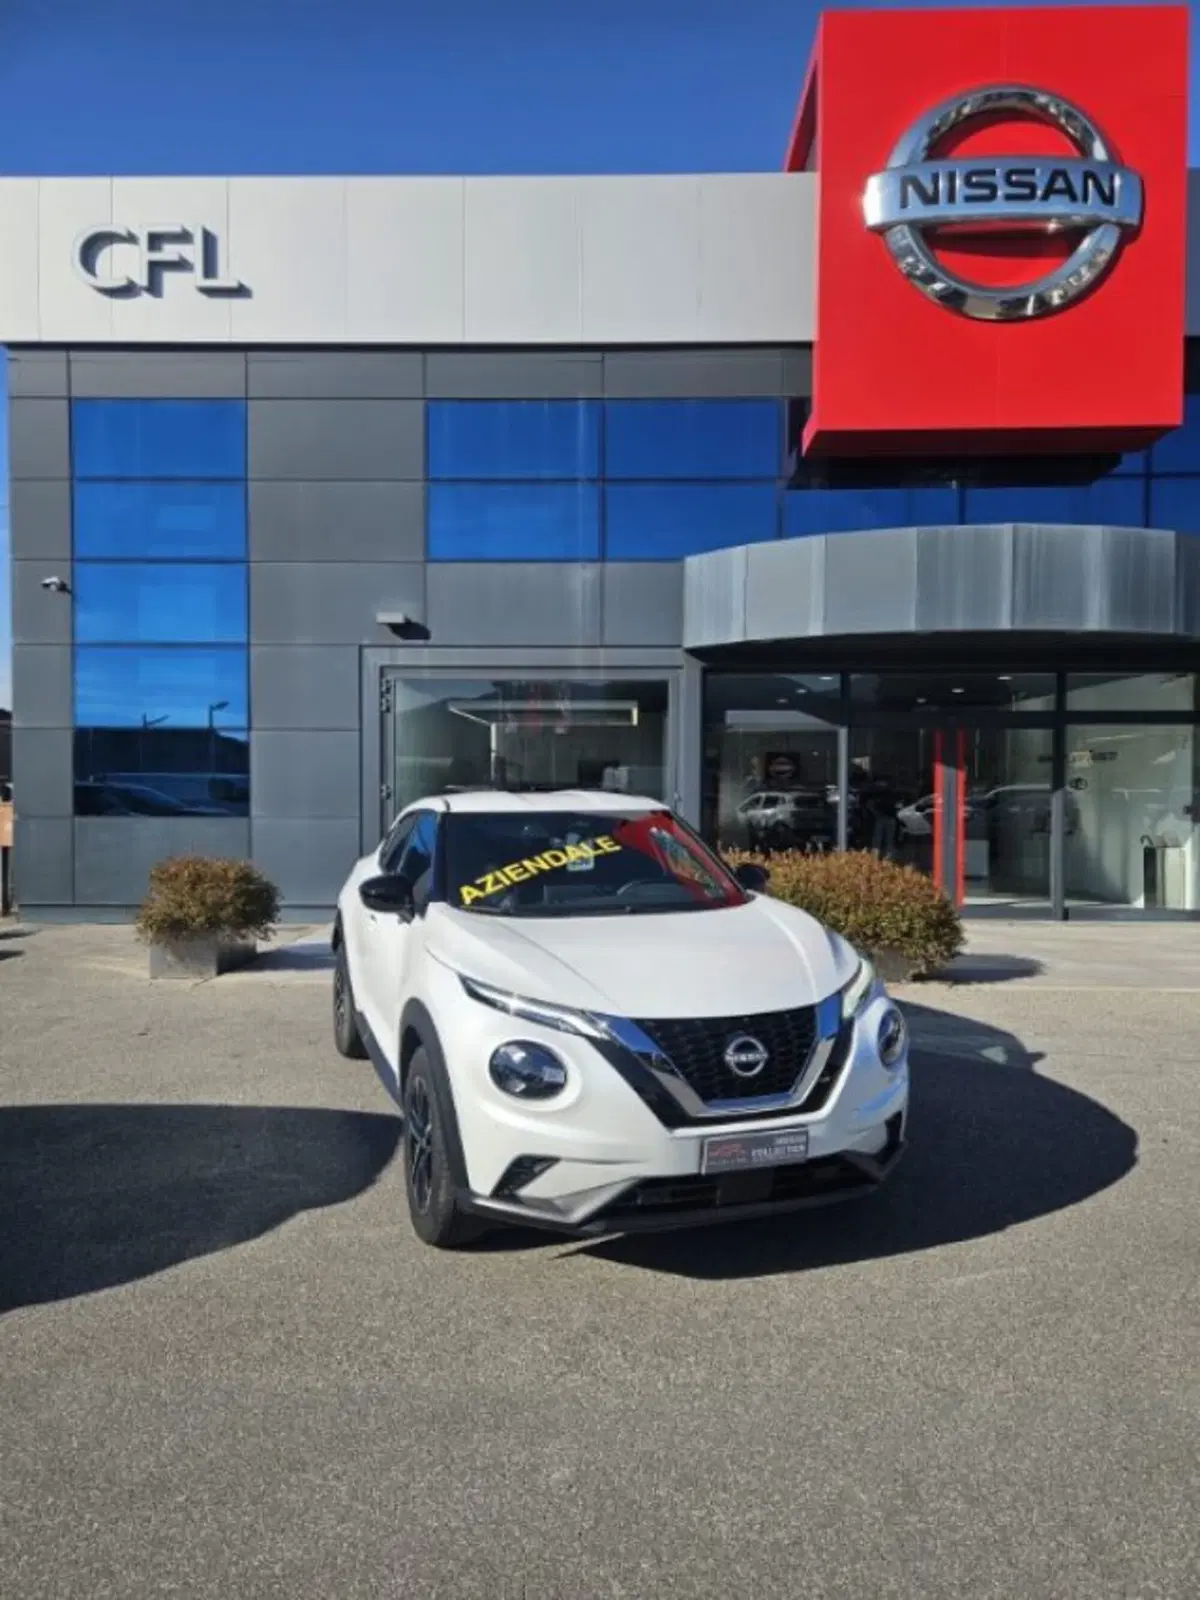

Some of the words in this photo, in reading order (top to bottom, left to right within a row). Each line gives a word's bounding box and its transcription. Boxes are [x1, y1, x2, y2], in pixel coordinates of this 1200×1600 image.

[899, 167, 1116, 209] NISSAN
[73, 223, 252, 300] CFL
[459, 834, 622, 906] AZIENDALE
